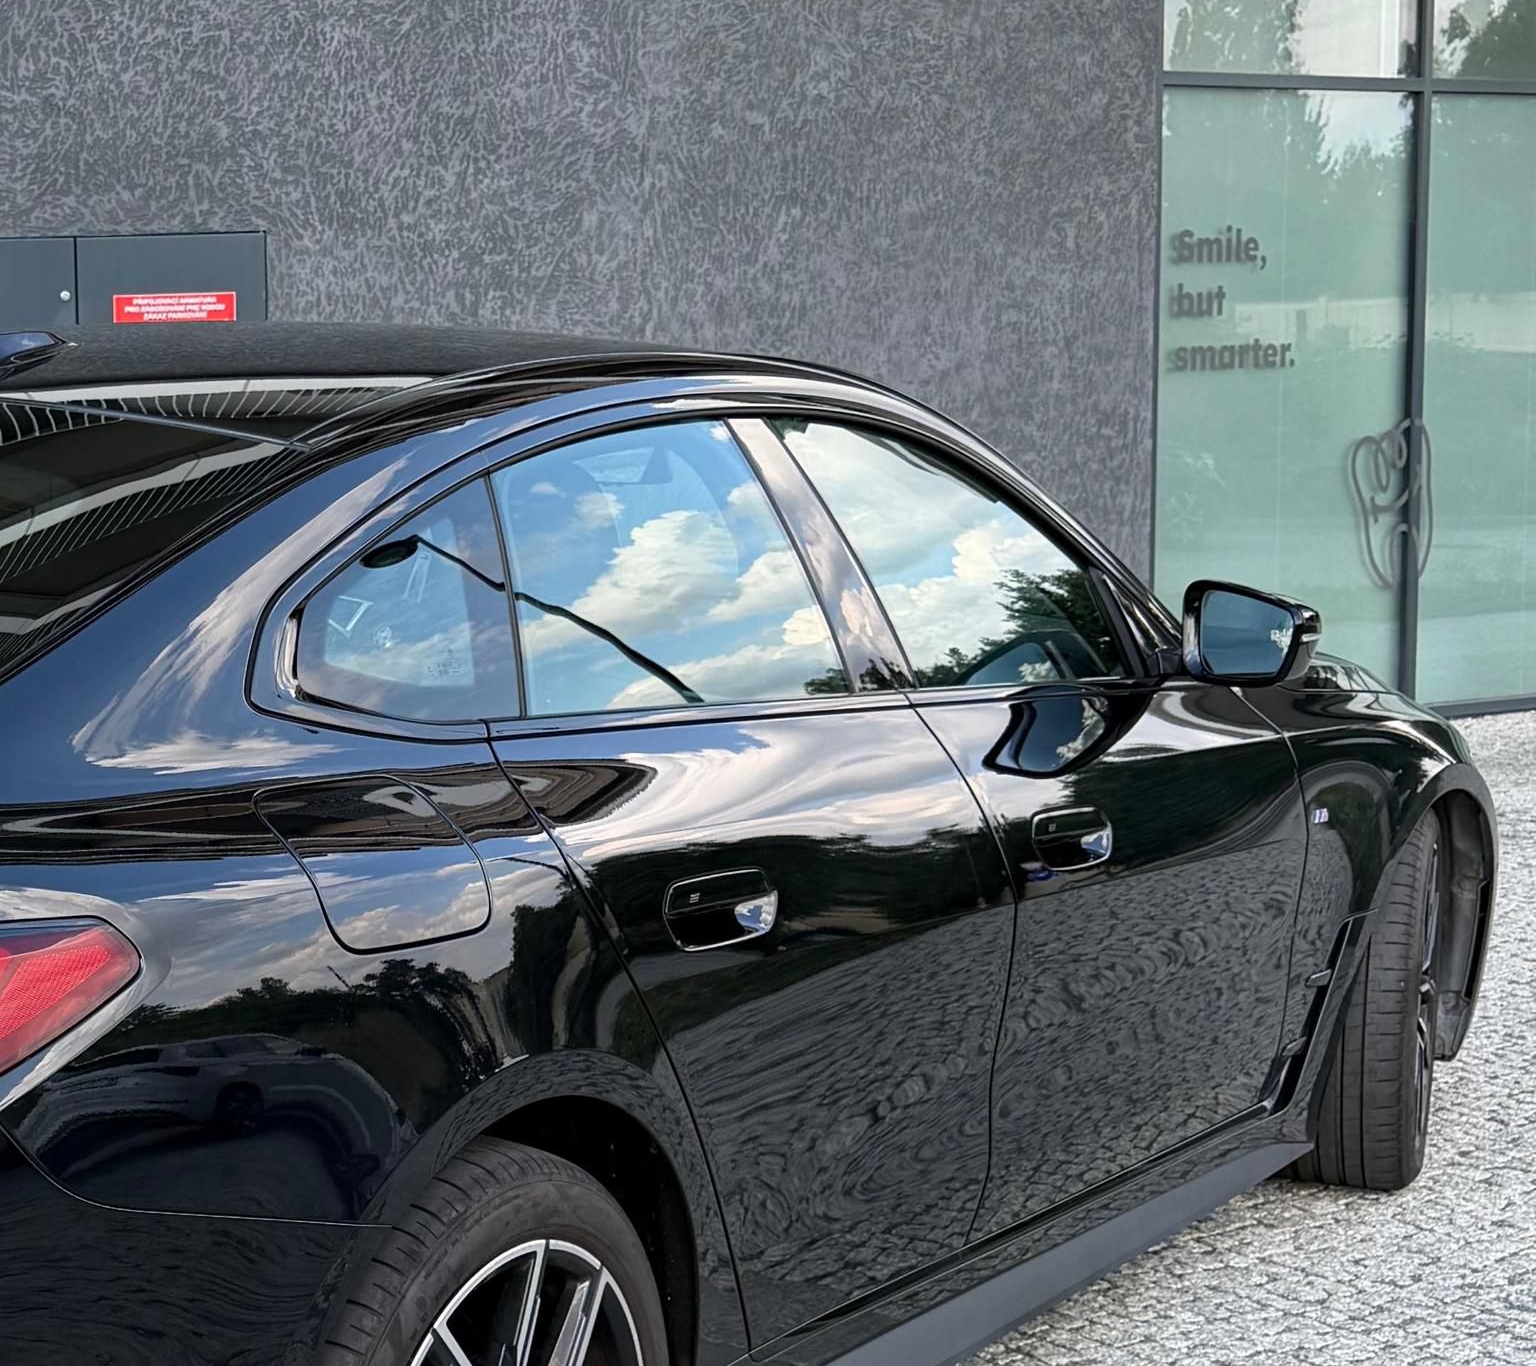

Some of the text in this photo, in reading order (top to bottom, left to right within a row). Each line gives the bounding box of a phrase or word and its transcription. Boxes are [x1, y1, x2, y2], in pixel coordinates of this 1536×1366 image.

[1175, 225, 1267, 270] Smile,
[1174, 283, 1226, 317] but
[1172, 338, 1296, 372] smarter.
